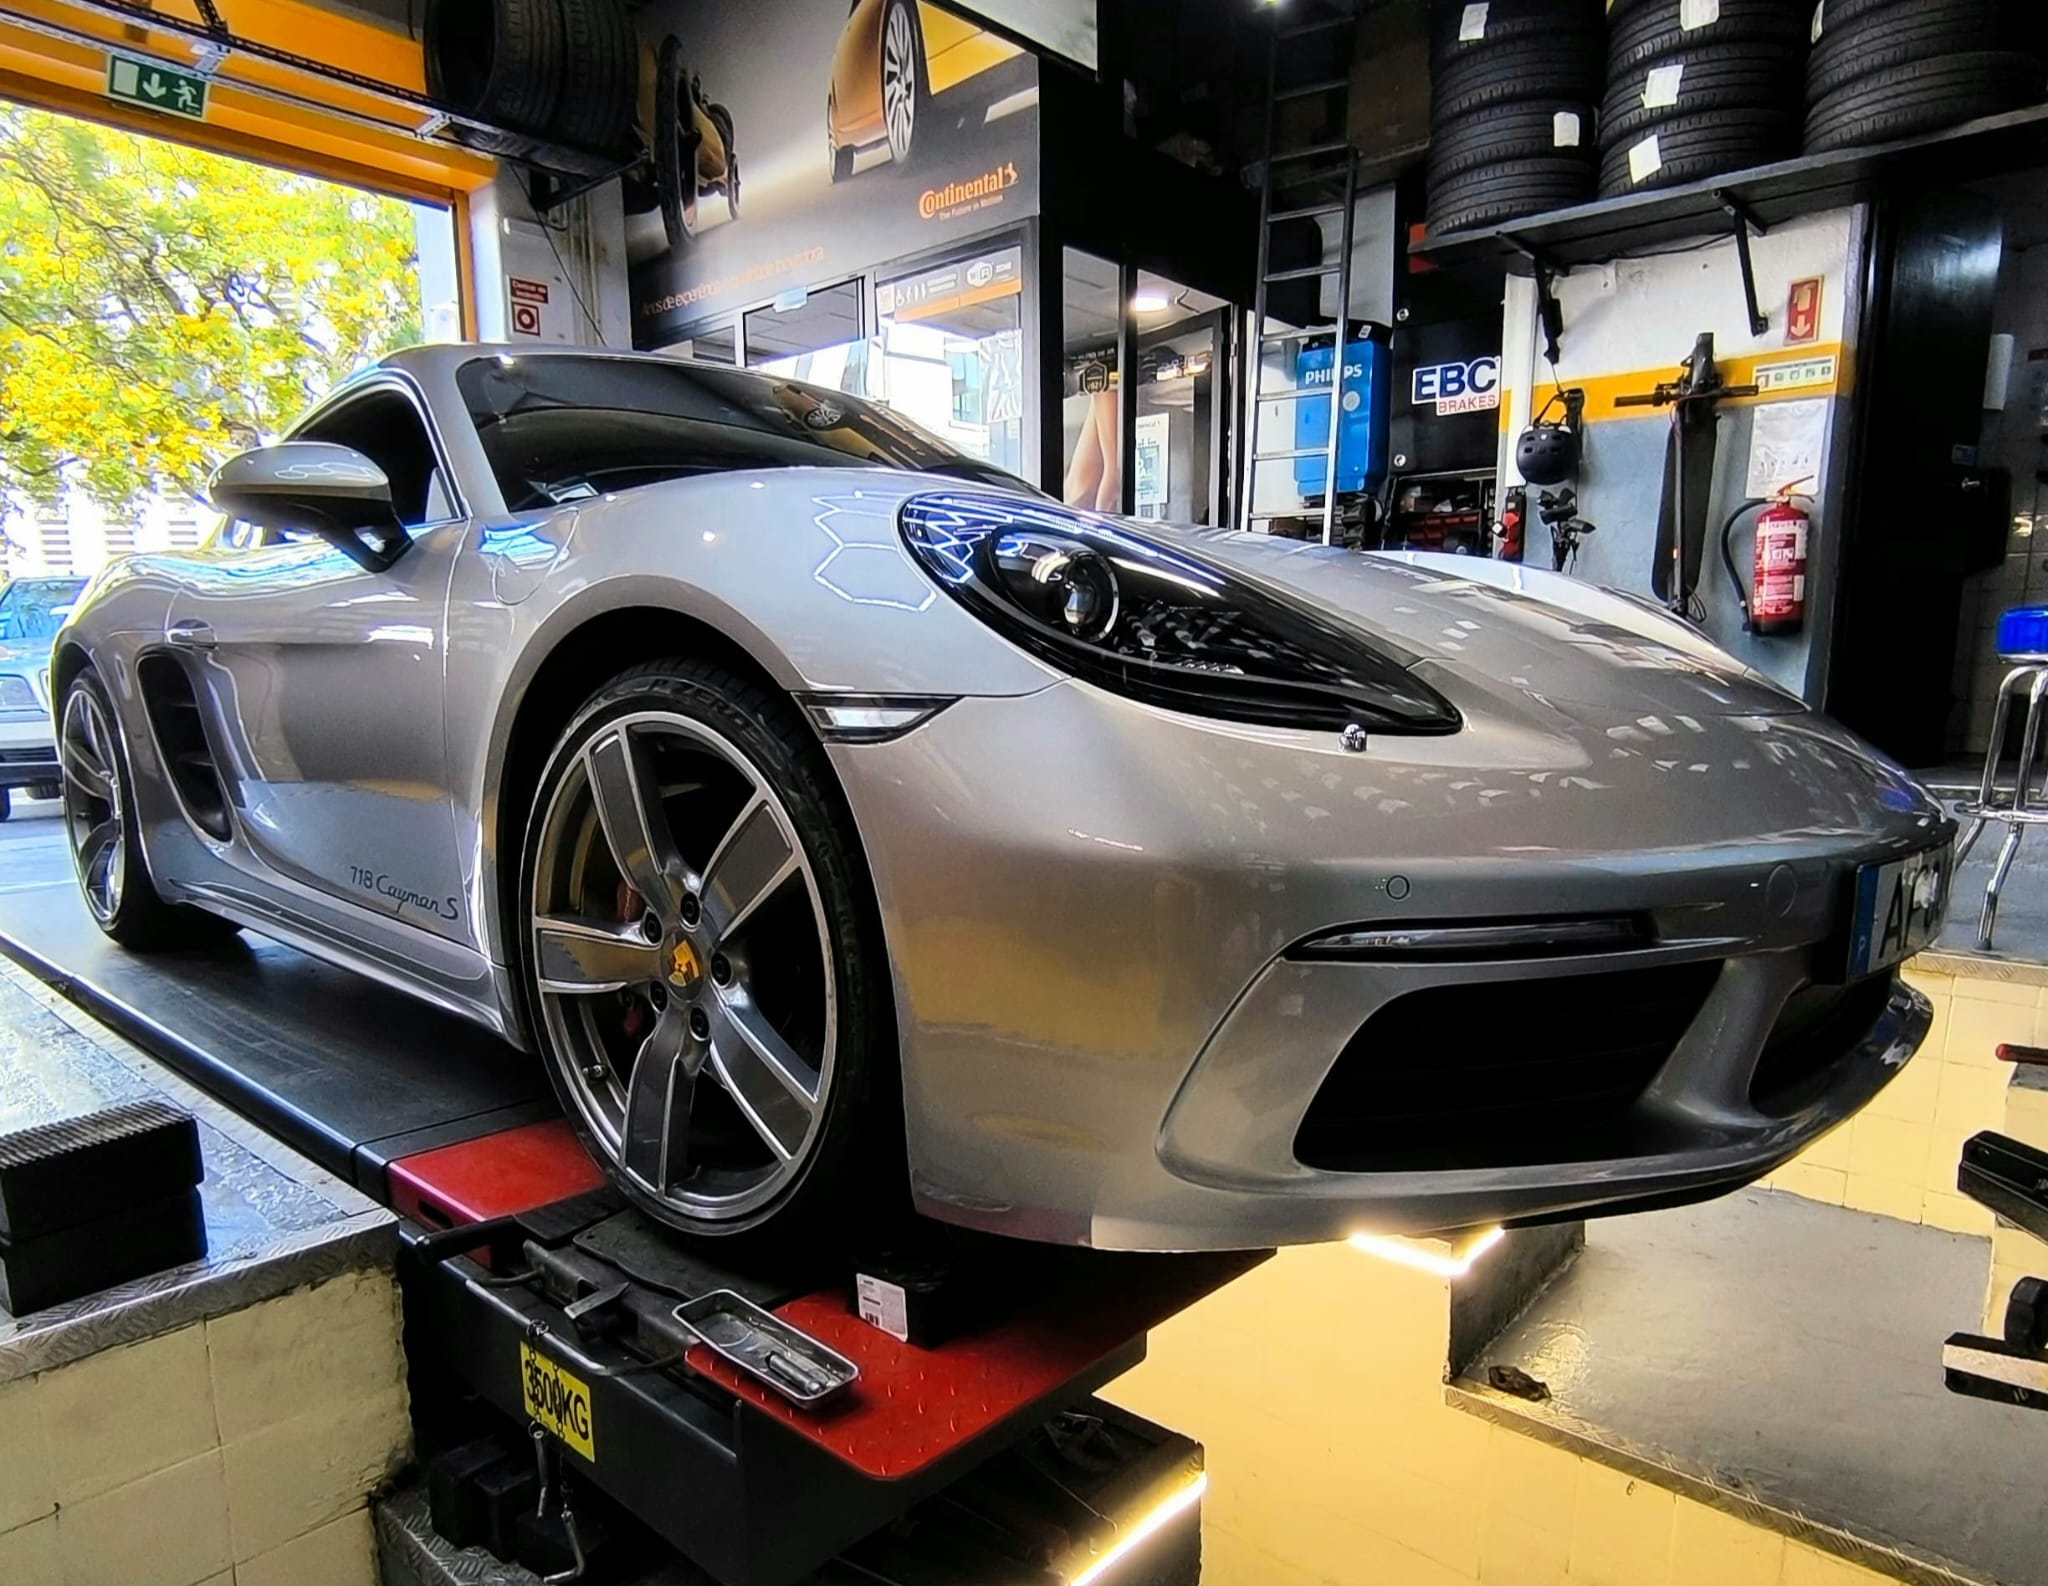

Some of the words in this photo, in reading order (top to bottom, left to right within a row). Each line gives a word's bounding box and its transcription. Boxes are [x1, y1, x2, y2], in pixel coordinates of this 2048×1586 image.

[919, 166, 1004, 219] Continental
[1305, 363, 1363, 385] PHIPS
[1415, 358, 1497, 401] EBC
[1438, 394, 1496, 413] BRAKES
[350, 865, 373, 889] 718
[376, 874, 440, 914] Cayman
[440, 897, 459, 920] S
